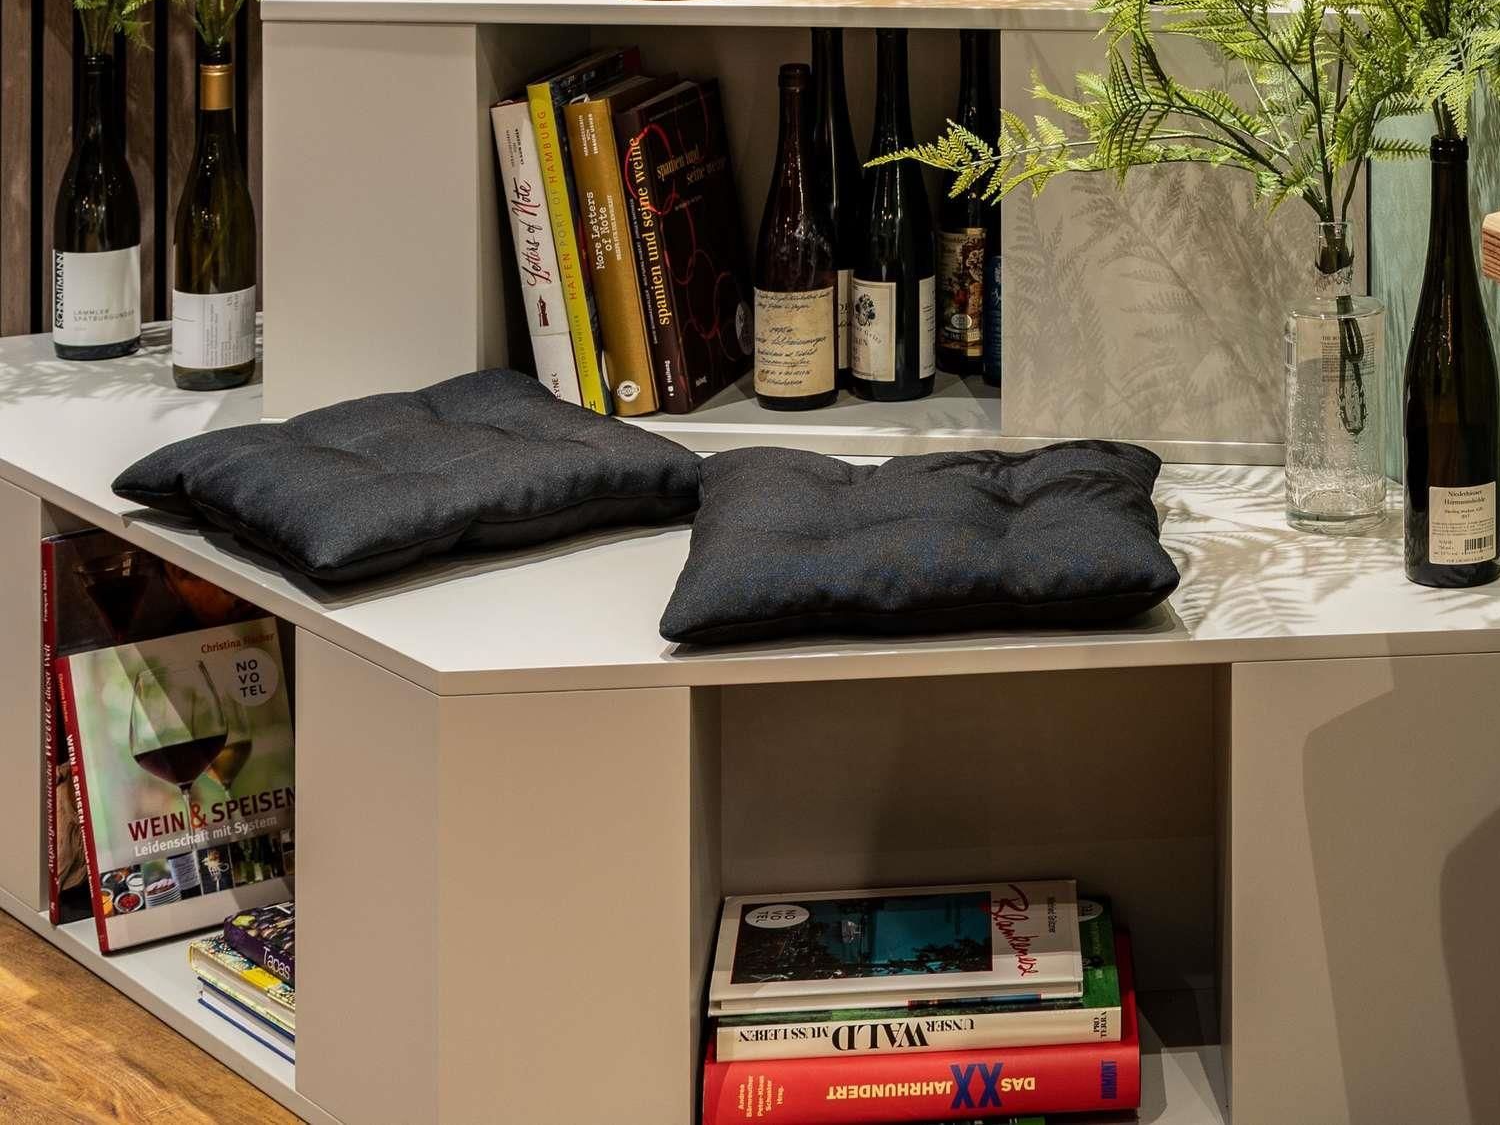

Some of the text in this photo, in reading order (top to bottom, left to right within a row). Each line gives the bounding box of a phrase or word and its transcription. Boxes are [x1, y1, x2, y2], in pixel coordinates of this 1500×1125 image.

[538, 109, 556, 185] HAMBURG
[511, 177, 541, 217] Note
[586, 191, 606, 271] More Letters
[598, 206, 612, 252] of Note
[629, 137, 672, 326] spanien und seine weine
[525, 235, 553, 289] Letters
[560, 252, 577, 301] HAFEN
[201, 639, 242, 653] Christina
[236, 659, 258, 673] NO
[238, 672, 260, 684] VO
[240, 684, 267, 698] TEL
[128, 789, 295, 842] WEIN & SPEISEN
[134, 816, 278, 857] Leidenschaft mit System
[263, 946, 292, 980] Tapas
[739, 1018, 976, 1051] UNSER WALD MUSS LEBEN
[1092, 1017, 1100, 1033] PRO
[1100, 1010, 1108, 1038] TERRA
[826, 1061, 1036, 1109] DAS XX JAHRHUNDERT
